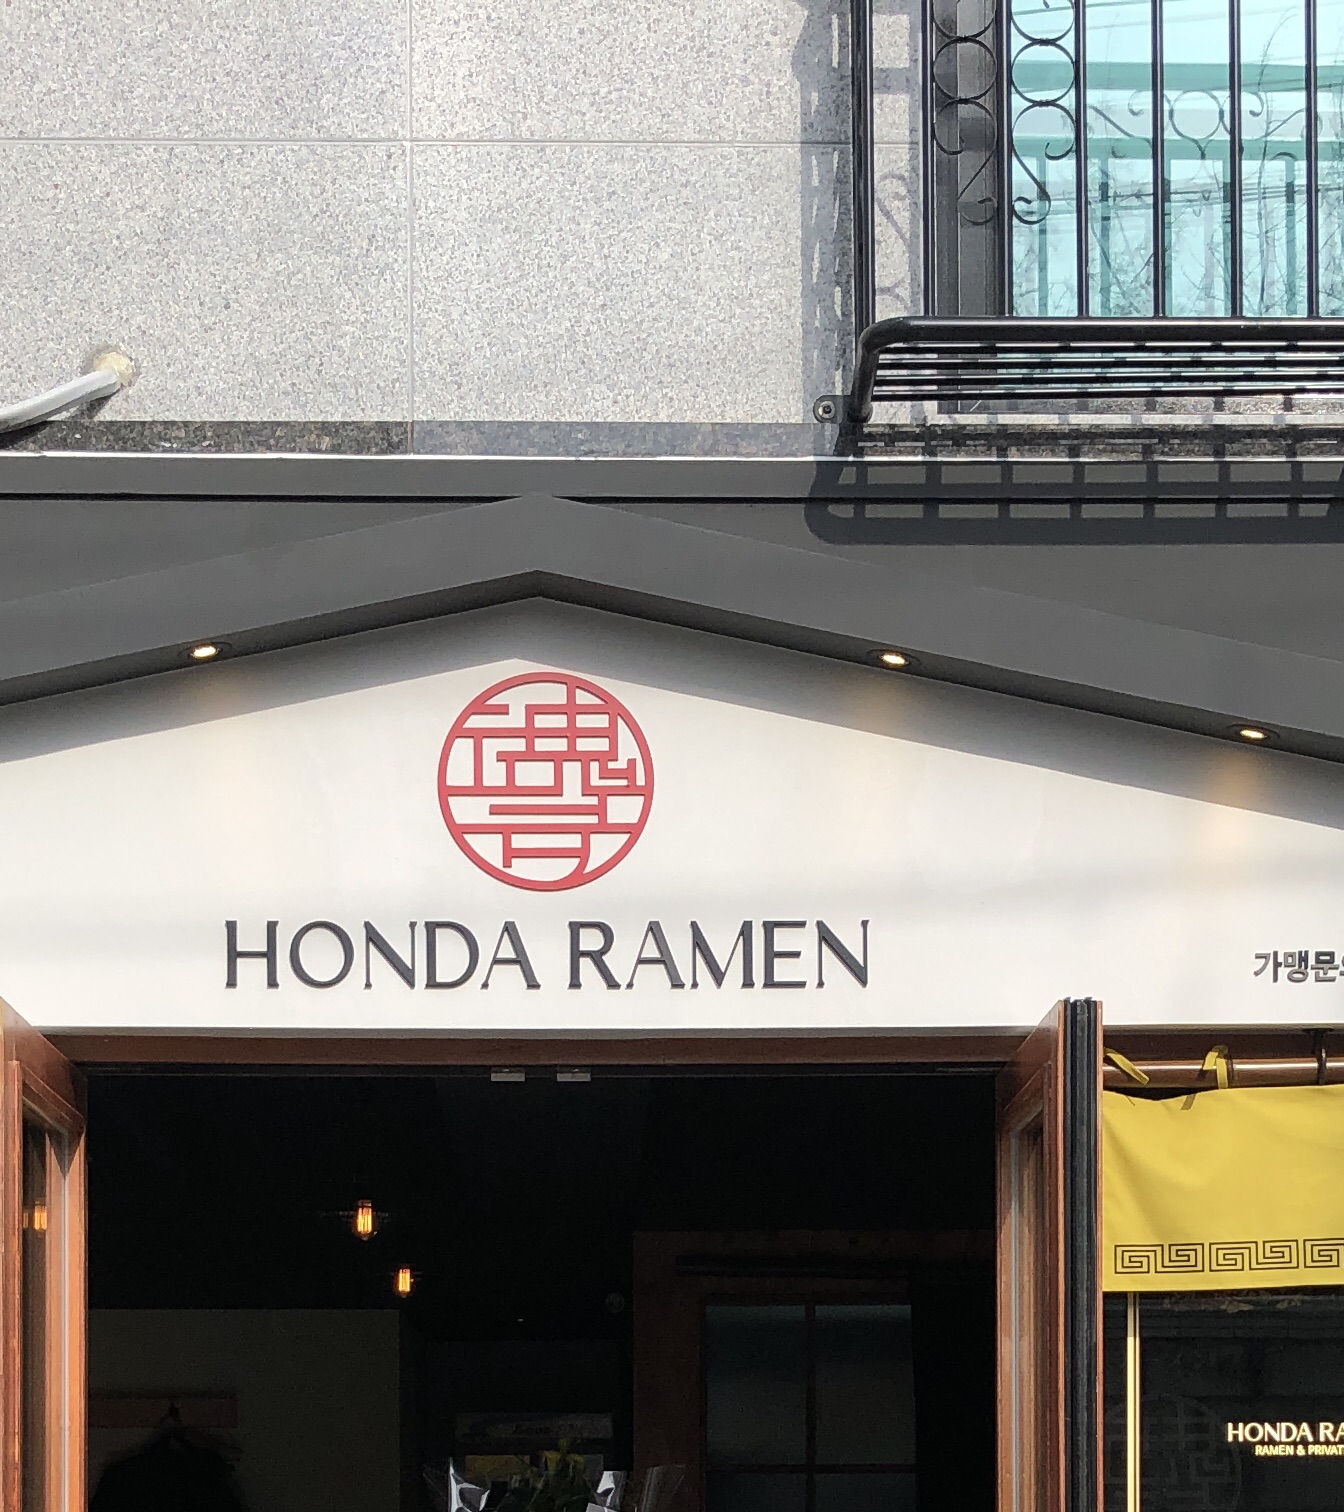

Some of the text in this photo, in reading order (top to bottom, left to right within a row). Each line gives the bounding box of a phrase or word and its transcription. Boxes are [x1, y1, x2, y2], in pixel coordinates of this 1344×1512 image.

[224, 919, 870, 991] HONDA RAMEN
[1227, 1422, 1314, 1442] HONDA
[1255, 1444, 1295, 1456] RAMEN
[1296, 1444, 1306, 1456] &
